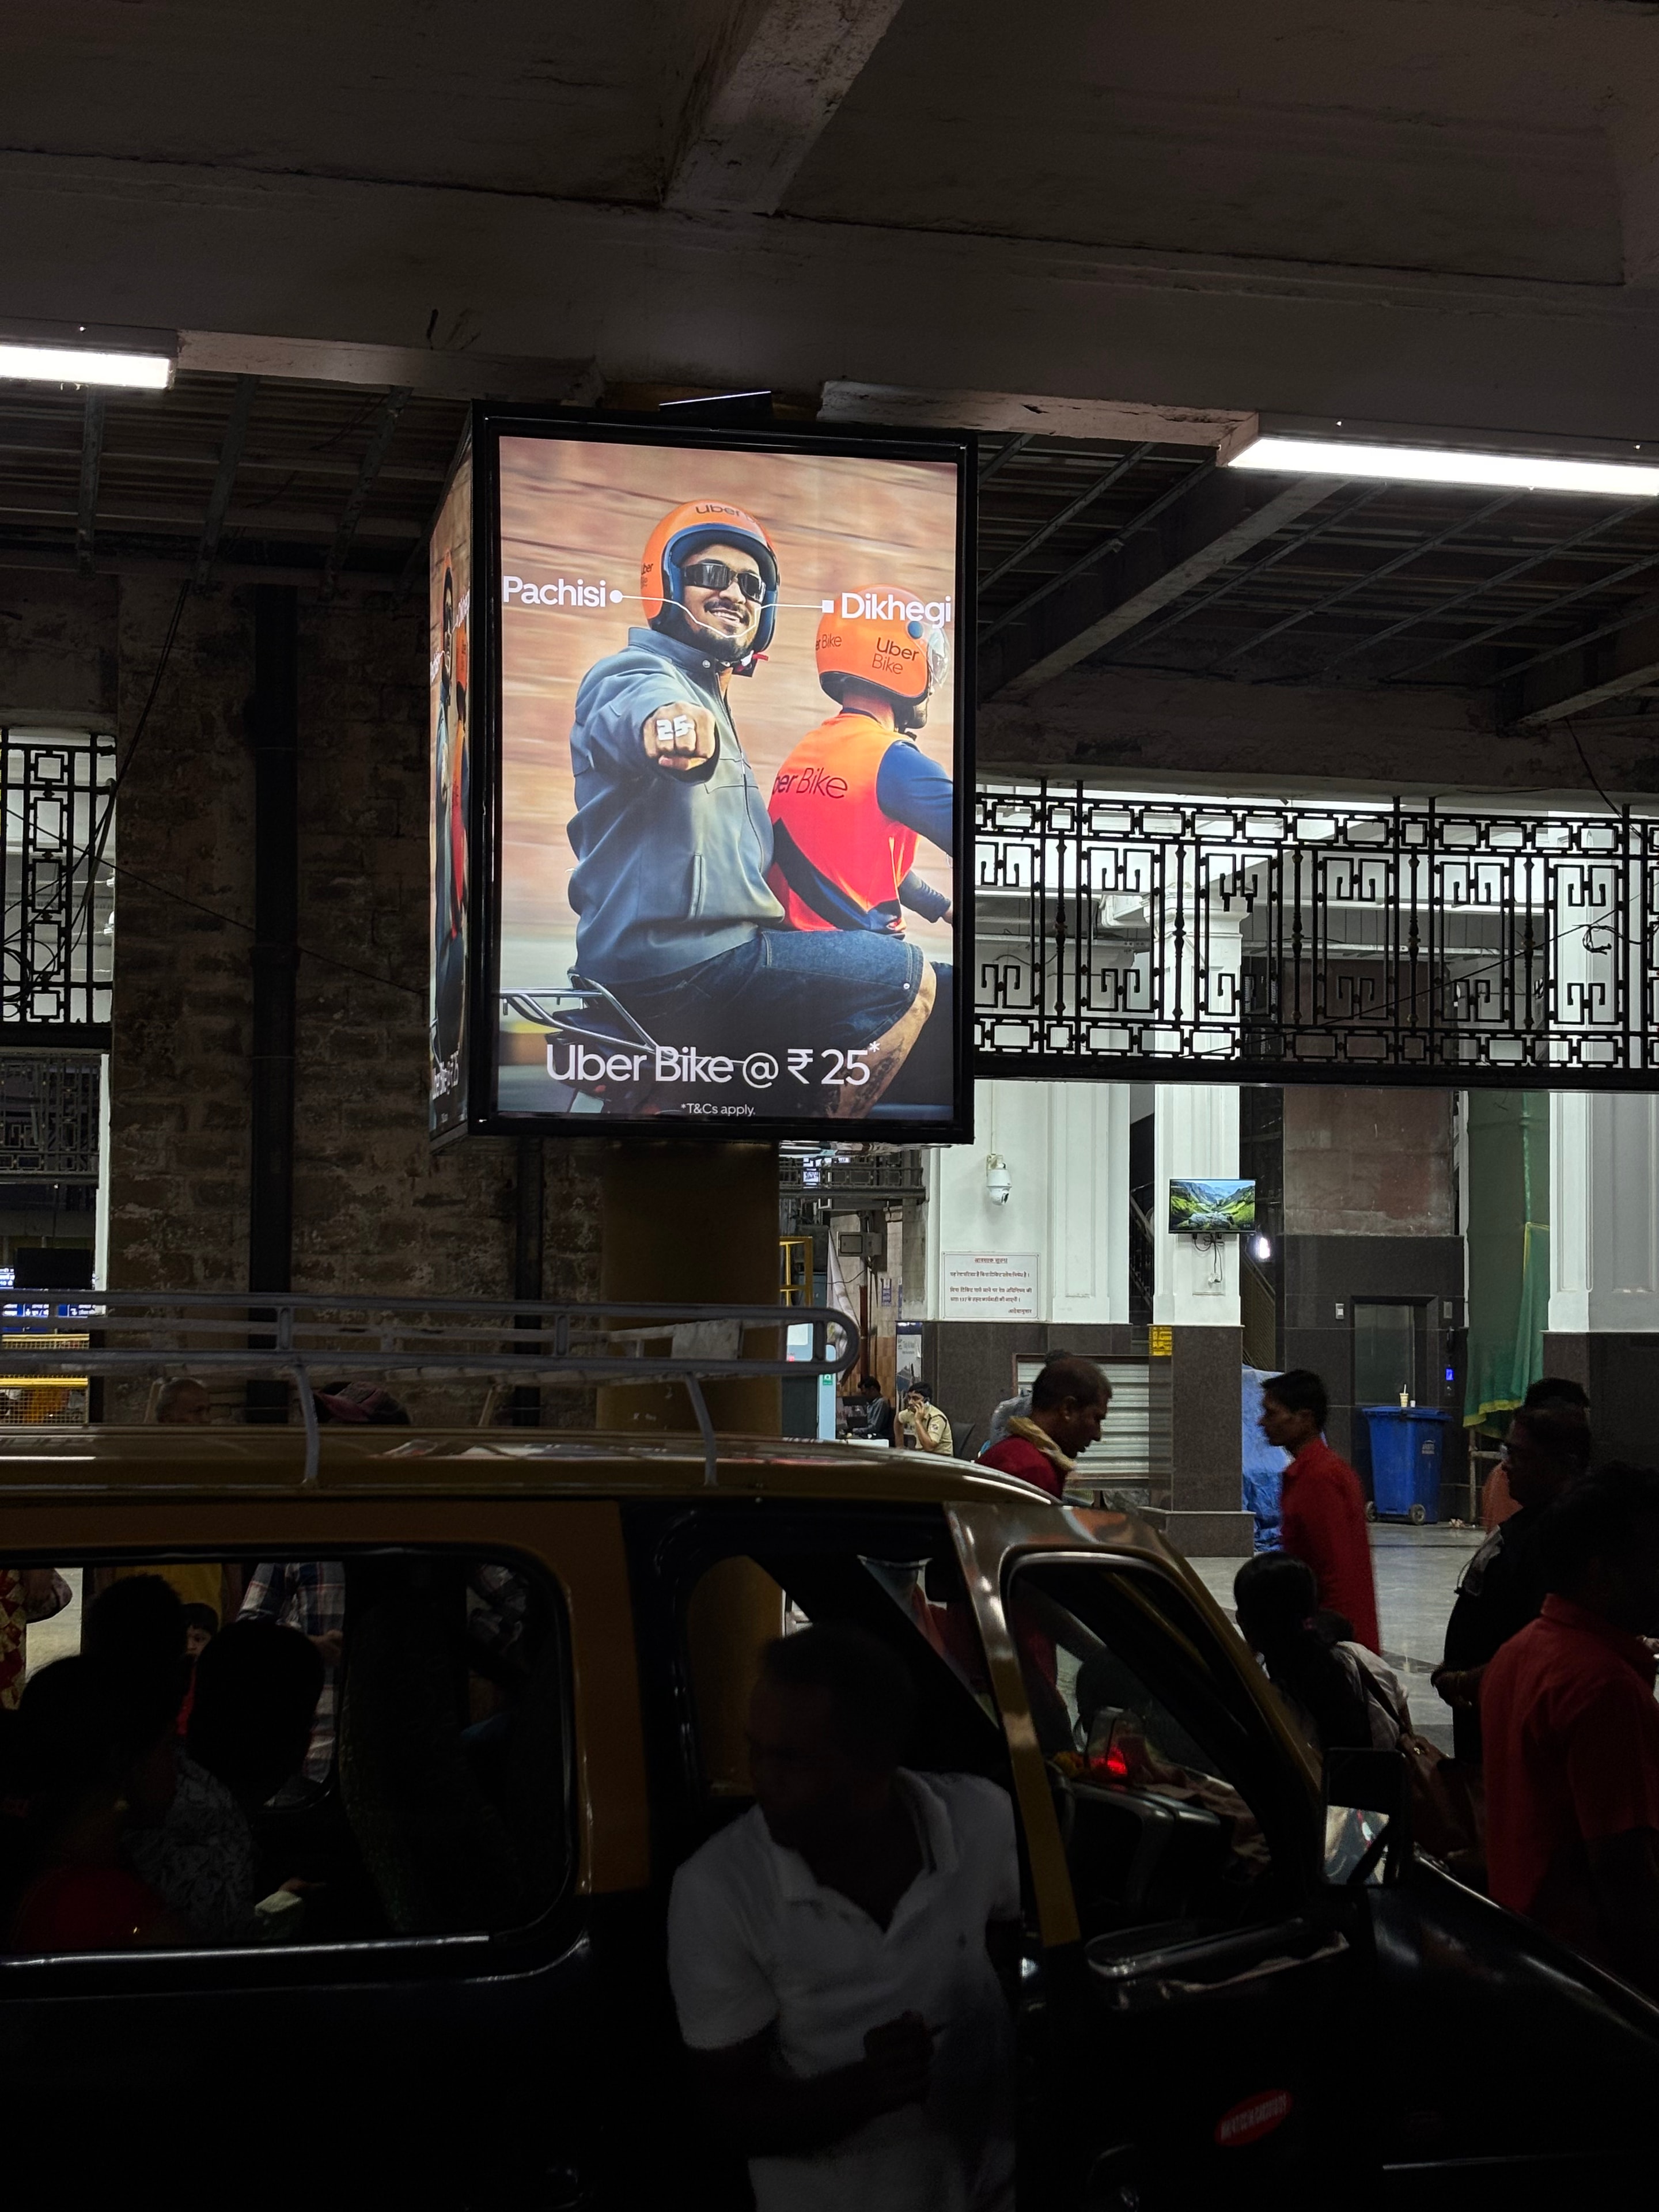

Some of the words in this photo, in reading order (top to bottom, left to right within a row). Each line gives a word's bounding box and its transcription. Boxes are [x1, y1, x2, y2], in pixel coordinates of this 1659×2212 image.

[695, 505, 740, 517] Uber
[503, 575, 606, 608] Pachisi
[842, 592, 951, 629] Dikhegi
[822, 633, 842, 649] Bike
[877, 637, 919, 662] Uber
[872, 653, 903, 675] Bike
[657, 714, 695, 741] 25
[796, 767, 848, 799] Bike
[547, 1044, 647, 1081] Uber
[655, 1044, 734, 1083] Bike
[742, 1052, 779, 1089] @
[787, 1048, 813, 1084] ₹
[720, 1104, 756, 1117] apply.
